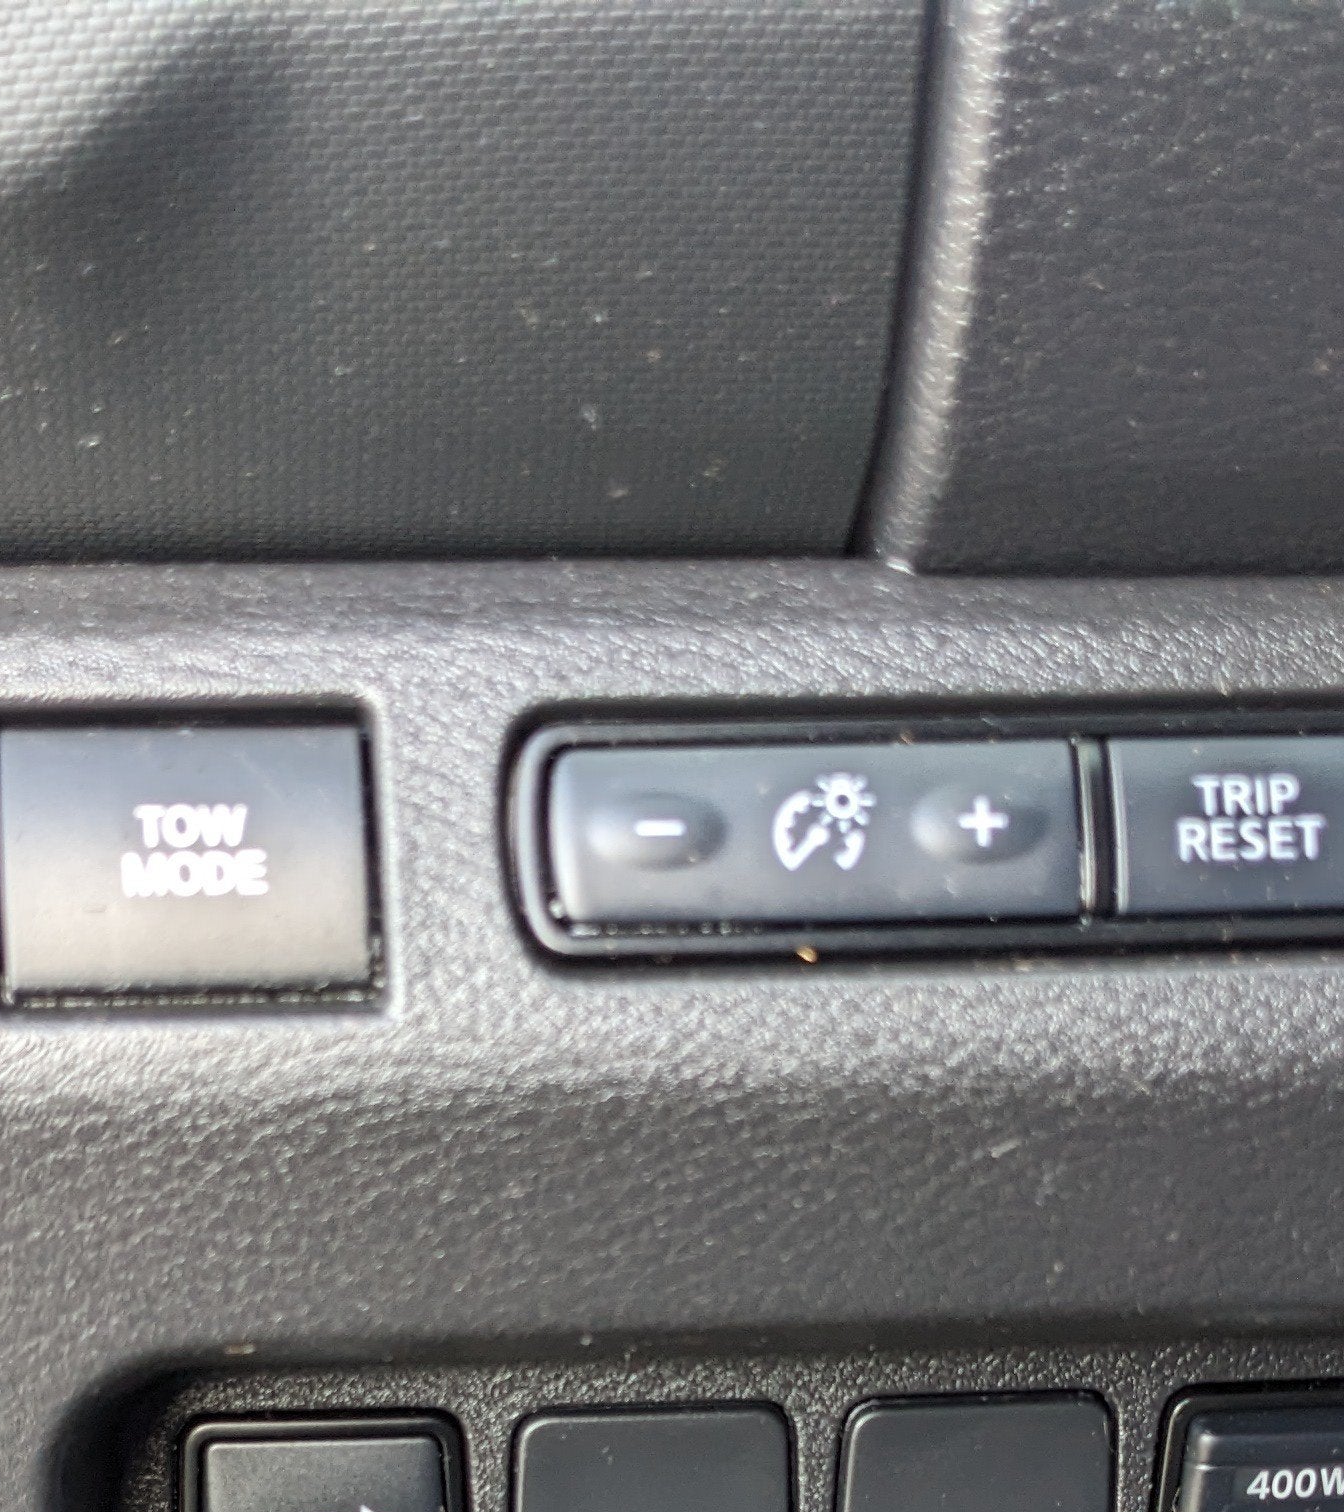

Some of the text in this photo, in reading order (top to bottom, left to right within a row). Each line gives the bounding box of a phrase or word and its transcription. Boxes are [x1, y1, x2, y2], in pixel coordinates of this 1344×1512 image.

[1191, 773, 1301, 816] TRIP
[132, 803, 248, 848] TOW
[1175, 813, 1328, 863] RESET
[120, 848, 270, 898] MODE
